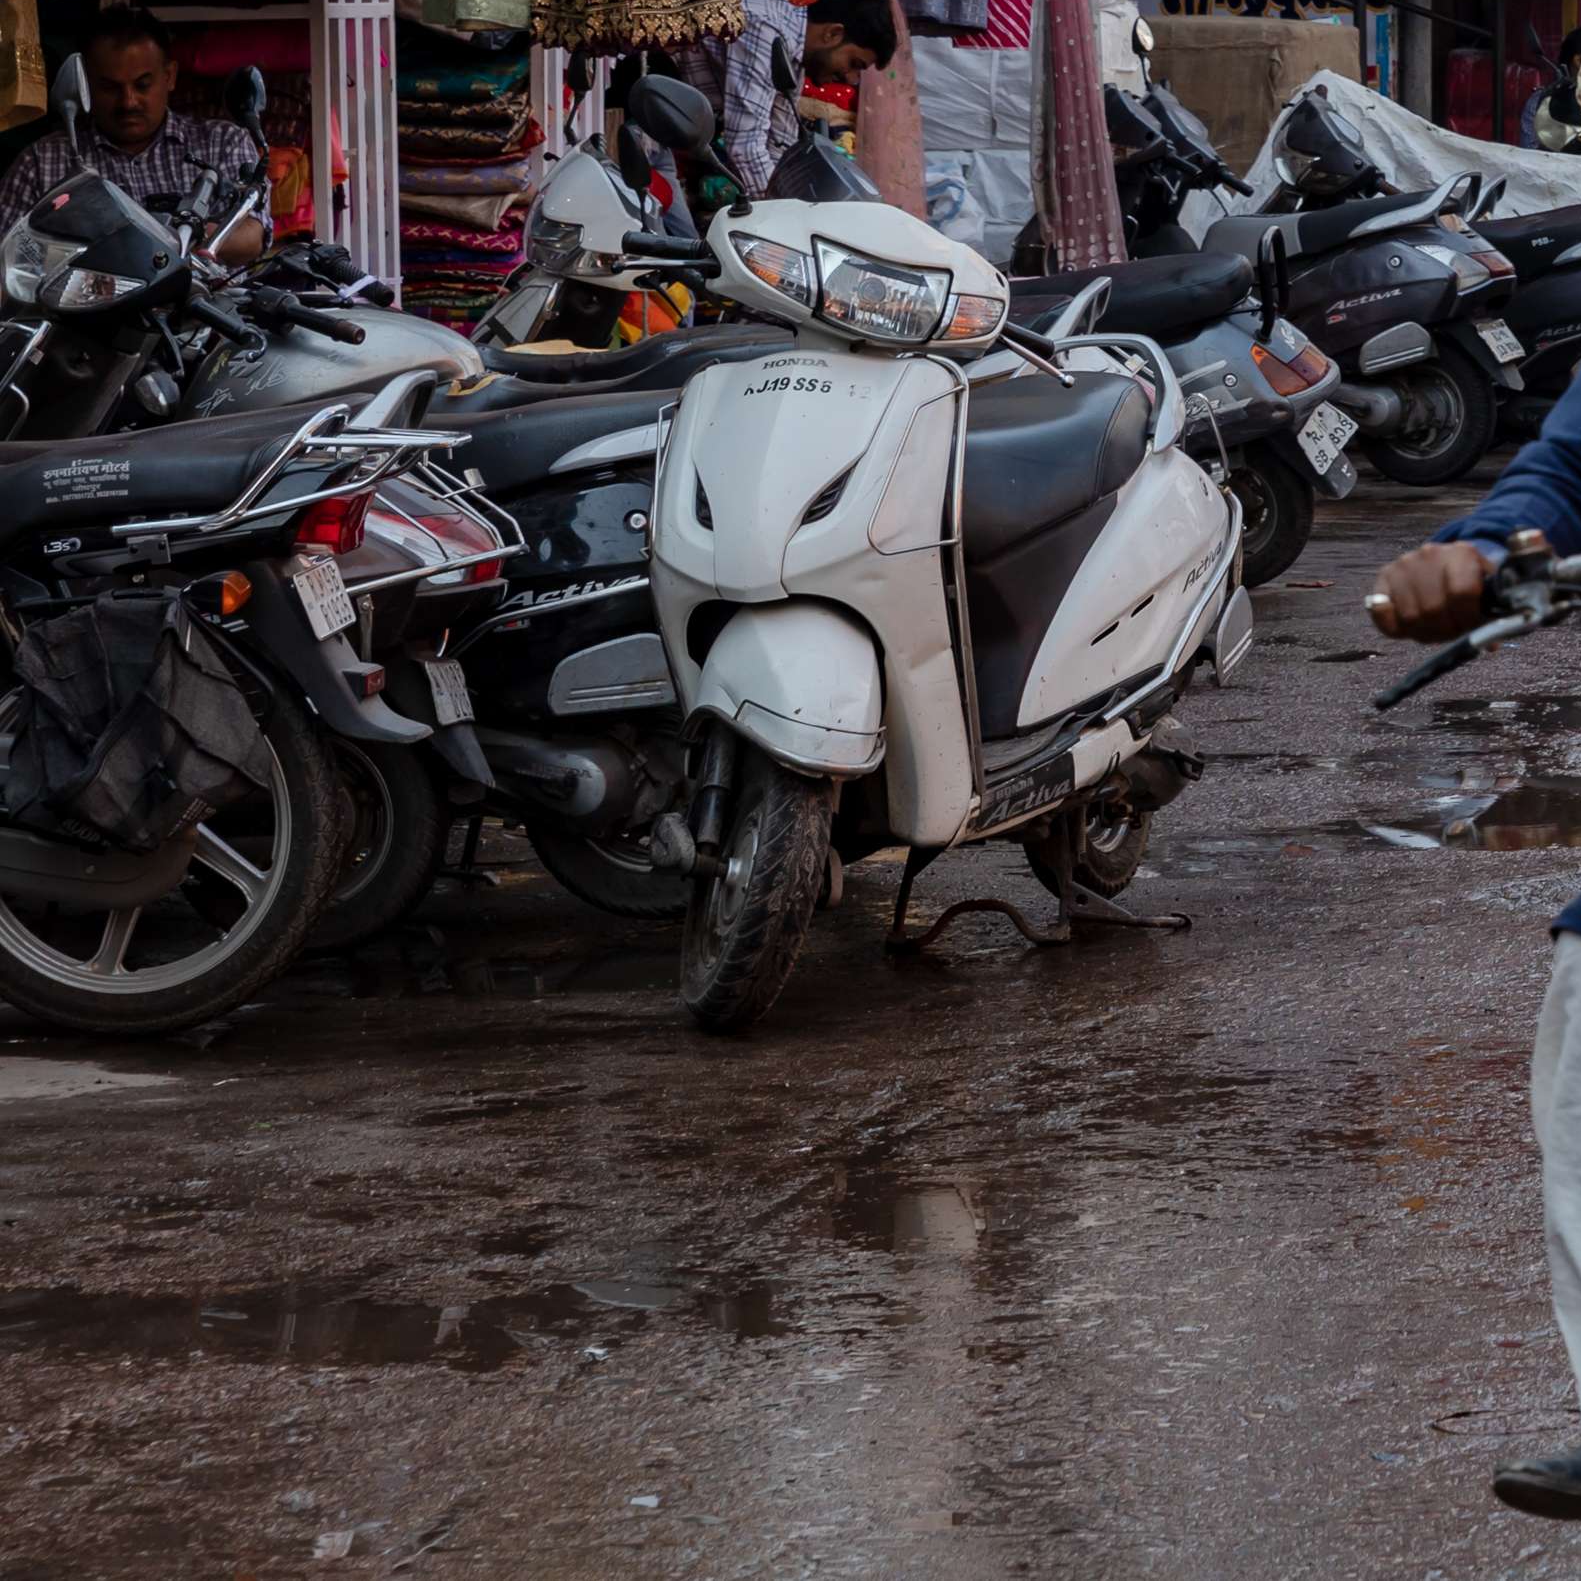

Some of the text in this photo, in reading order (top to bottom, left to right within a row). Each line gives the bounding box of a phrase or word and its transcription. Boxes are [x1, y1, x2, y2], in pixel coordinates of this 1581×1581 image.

[1324, 285, 1404, 316] Activa
[763, 356, 829, 371] HONDA
[1182, 541, 1224, 595] Activa
[980, 778, 1073, 822] Activa
